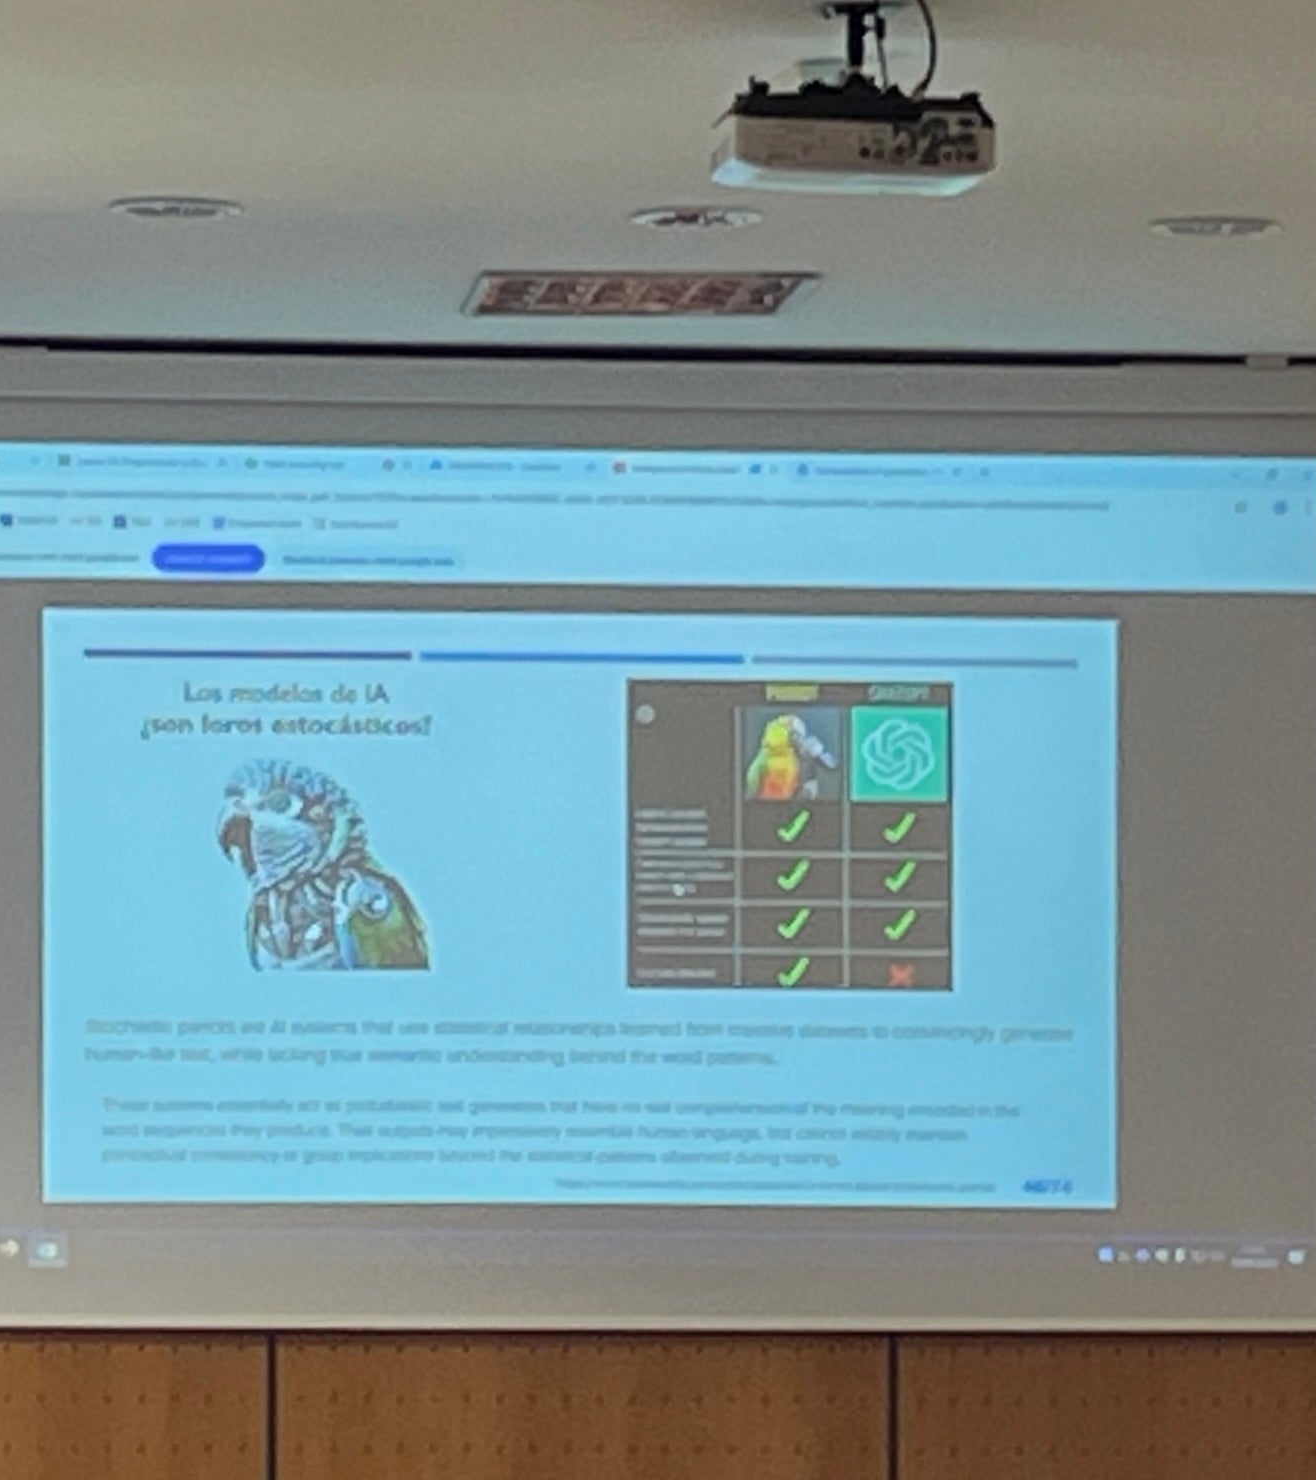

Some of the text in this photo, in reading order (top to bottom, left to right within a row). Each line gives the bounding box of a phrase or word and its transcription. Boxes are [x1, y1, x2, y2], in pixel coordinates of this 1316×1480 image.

[183, 680, 389, 703] Los modelos de IA
